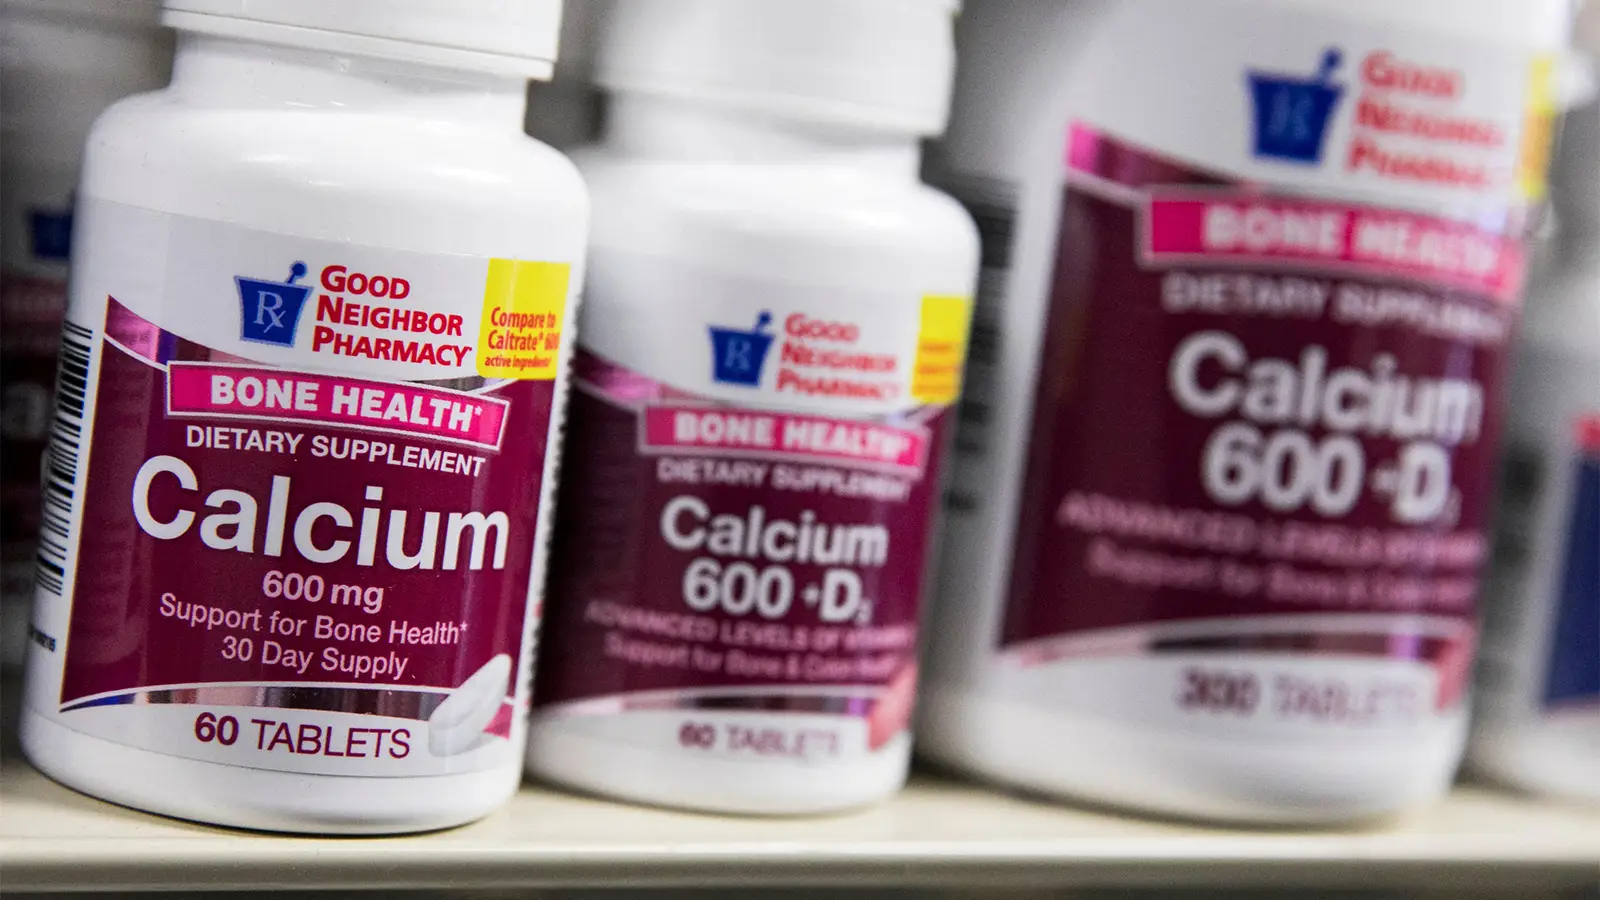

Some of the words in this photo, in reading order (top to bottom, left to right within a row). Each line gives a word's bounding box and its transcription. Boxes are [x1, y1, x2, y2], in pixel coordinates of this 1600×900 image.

[320, 265, 410, 300] GOOD
[316, 295, 463, 337] NEIGHBOR
[491, 306, 545, 333] Compare
[312, 325, 472, 367] PHARMACY
[485, 354, 511, 367] active
[211, 375, 319, 412] BONE
[1168, 330, 1483, 441] Calcium
[674, 411, 776, 446] BONE
[186, 425, 304, 454] DIETARY
[310, 436, 486, 476] SUPPLEMENT
[656, 457, 767, 487] DIETARY
[1202, 422, 1366, 516] 600
[132, 454, 510, 571] Calcium
[660, 495, 889, 566] Calcium
[262, 570, 324, 602] 600
[331, 583, 385, 613] mg
[682, 558, 794, 618] 600
[159, 593, 262, 631] Support
[269, 610, 308, 636] for
[314, 615, 381, 642] Bone
[221, 636, 254, 662] 30
[261, 640, 314, 674] Day
[321, 648, 408, 679] Supply
[194, 711, 239, 746] 60
[250, 718, 411, 759] TABLETS
